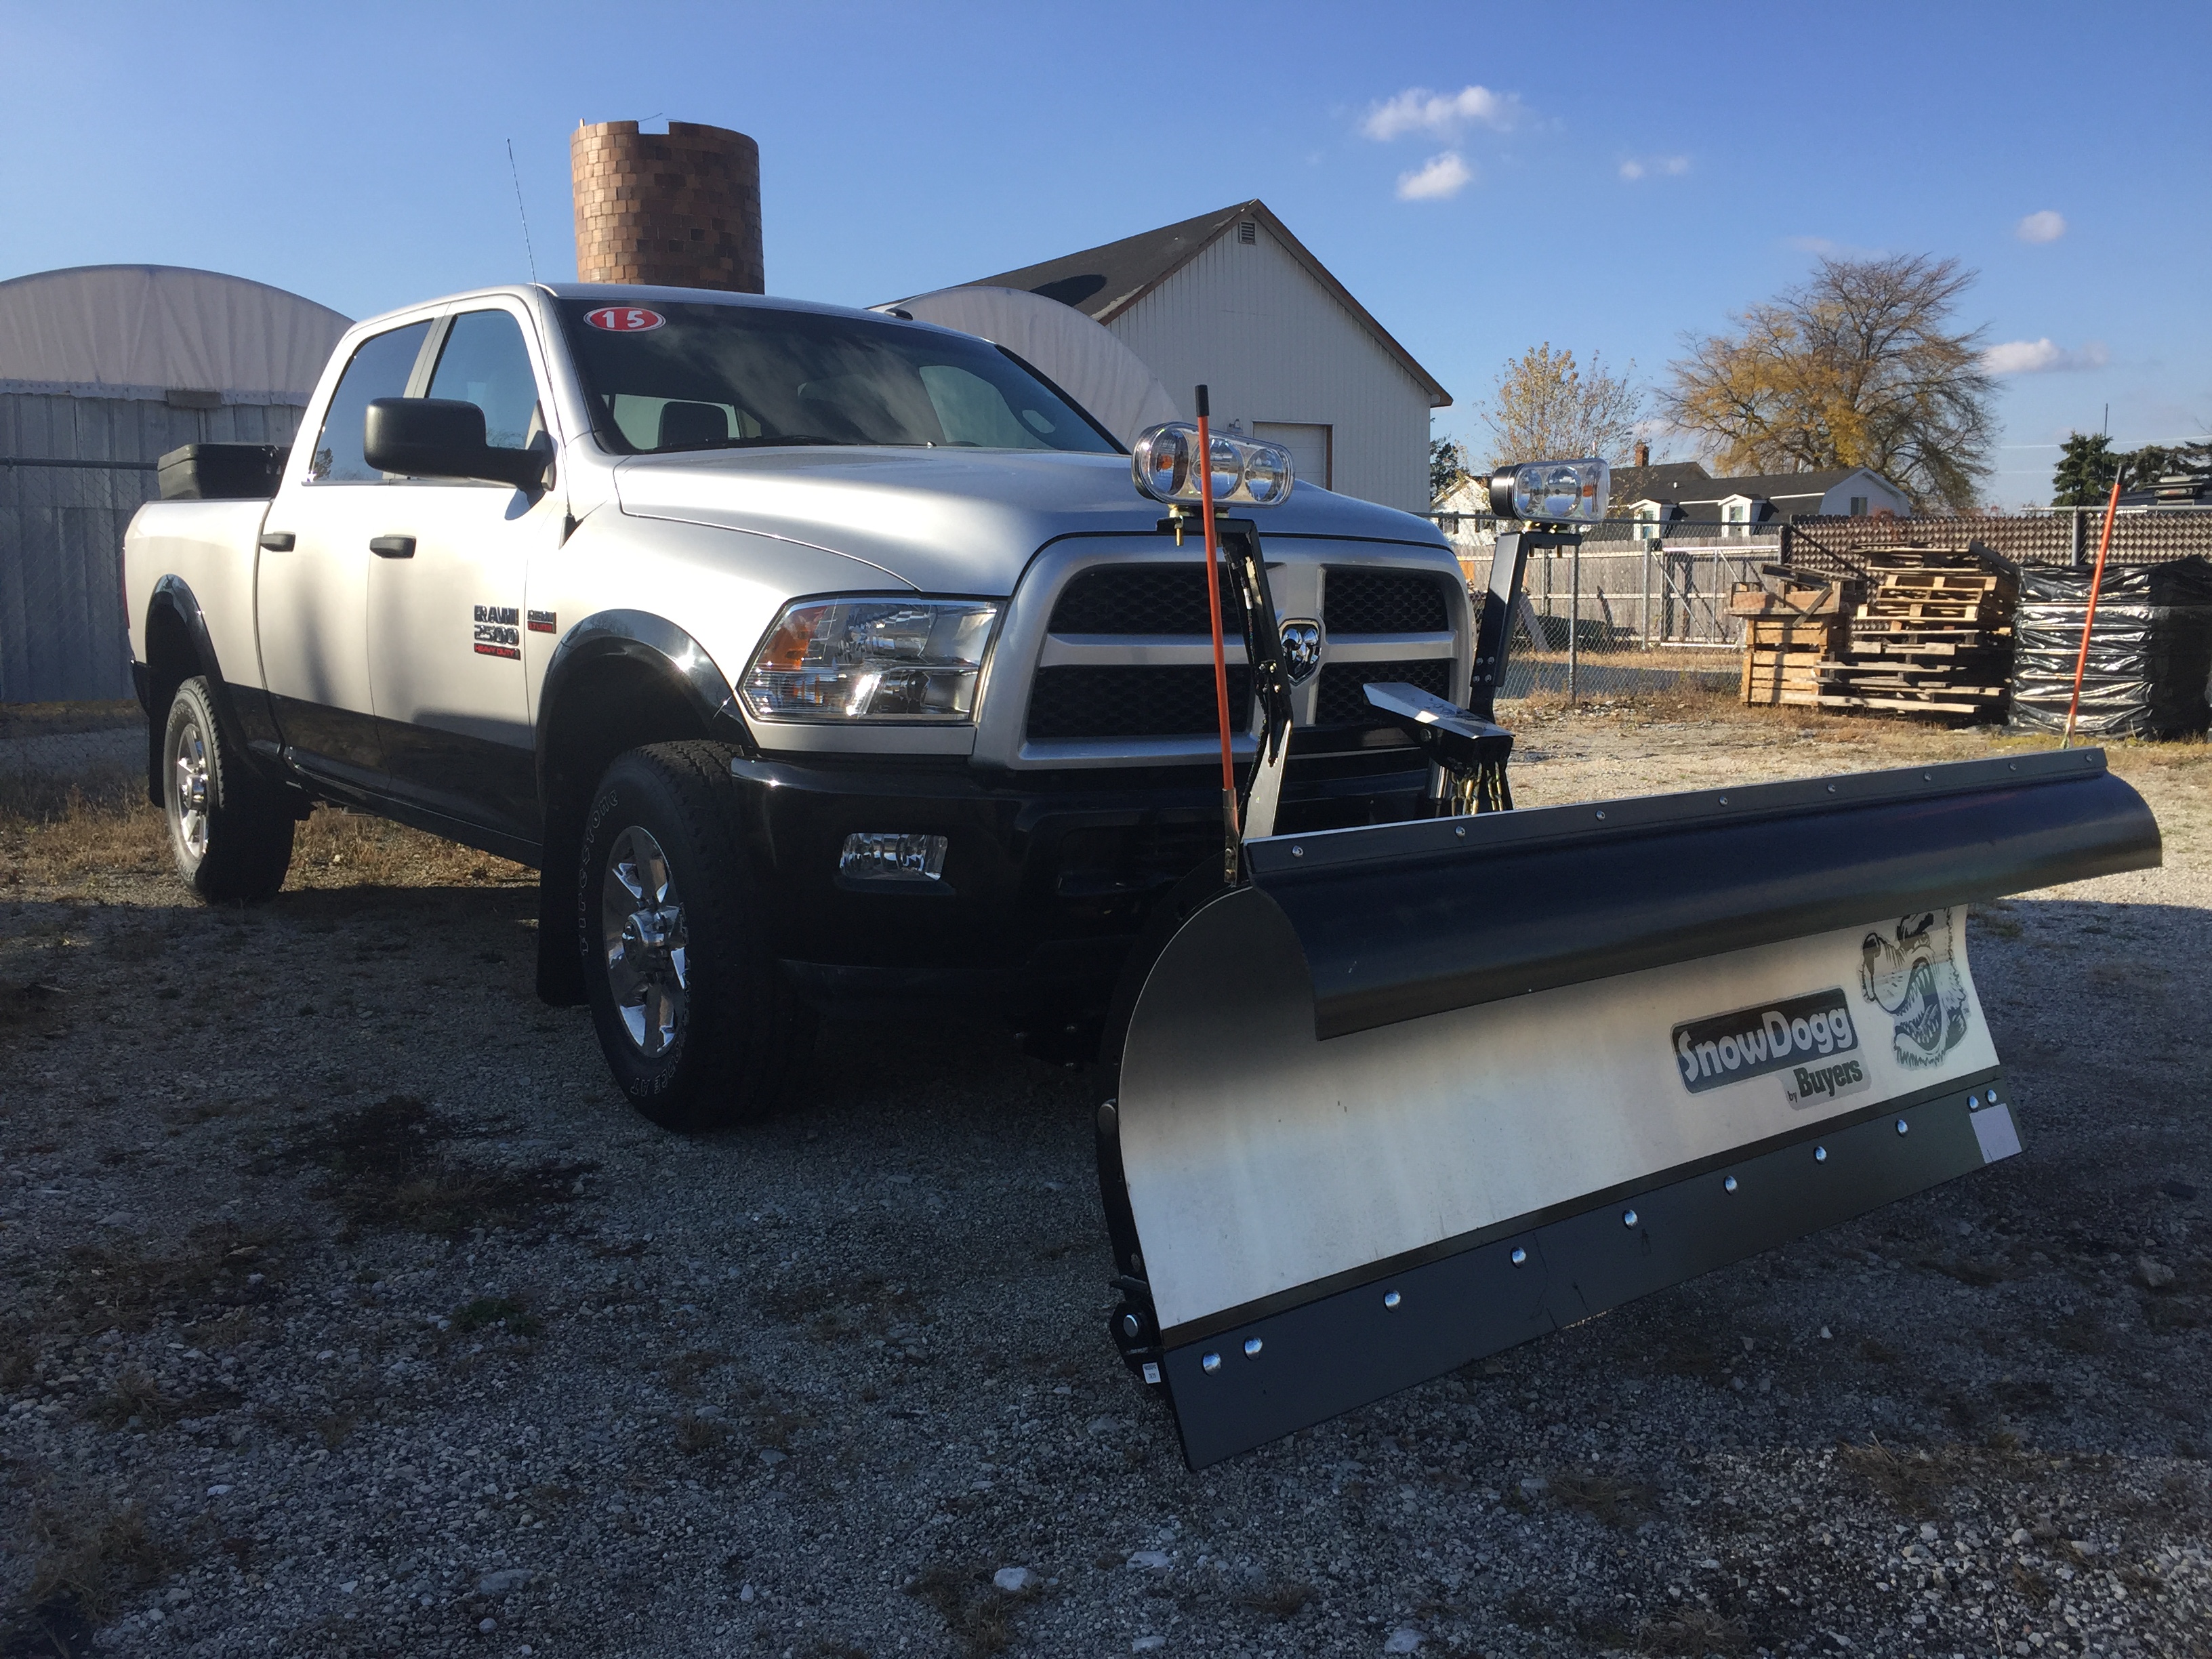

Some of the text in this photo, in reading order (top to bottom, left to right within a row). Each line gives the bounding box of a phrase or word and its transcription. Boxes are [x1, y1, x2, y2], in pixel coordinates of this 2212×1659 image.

[602, 310, 644, 328] 15
[474, 605, 519, 626] RAM
[474, 625, 519, 646] 2500
[475, 644, 514, 657] HEAVY DUTY
[1678, 1008, 1853, 1082] SnowDogg
[1788, 1060, 1863, 1103] by Buyers
